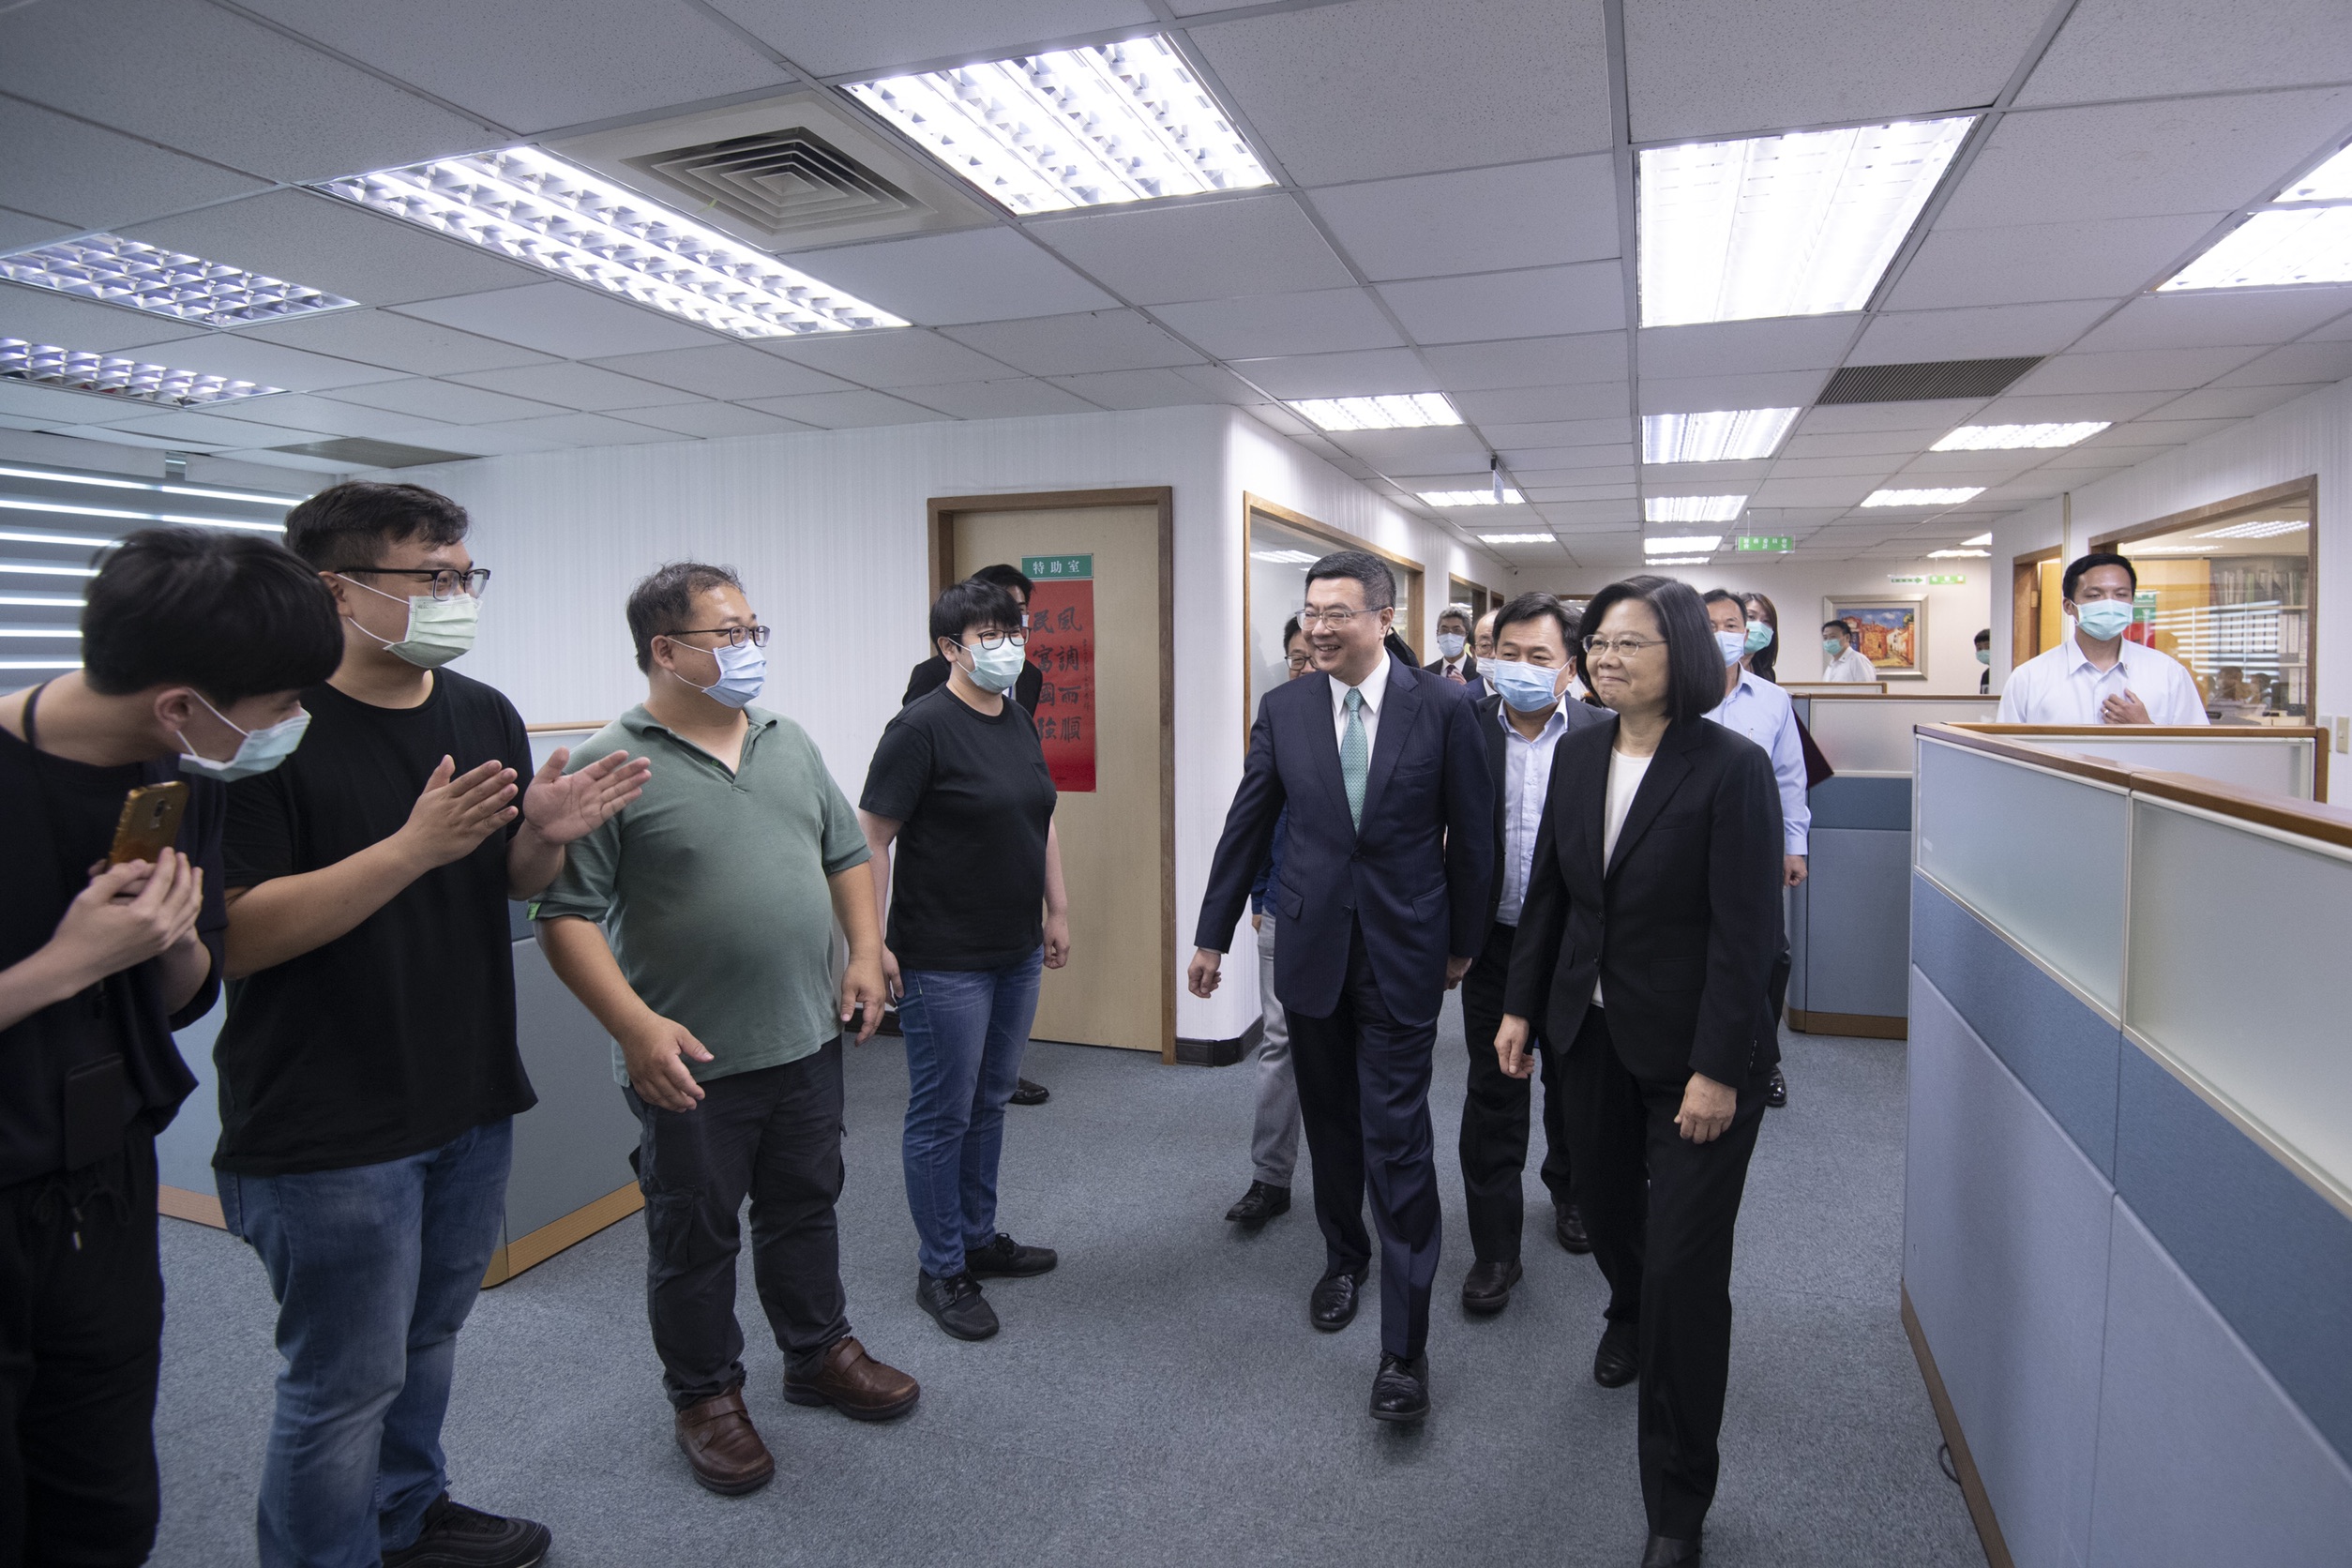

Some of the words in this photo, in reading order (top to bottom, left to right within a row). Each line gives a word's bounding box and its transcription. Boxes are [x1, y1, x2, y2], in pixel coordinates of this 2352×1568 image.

[1033, 560, 1080, 574] 特助室
[1033, 609, 1057, 741] 民富國強
[1056, 606, 1083, 743] 風調雨順
